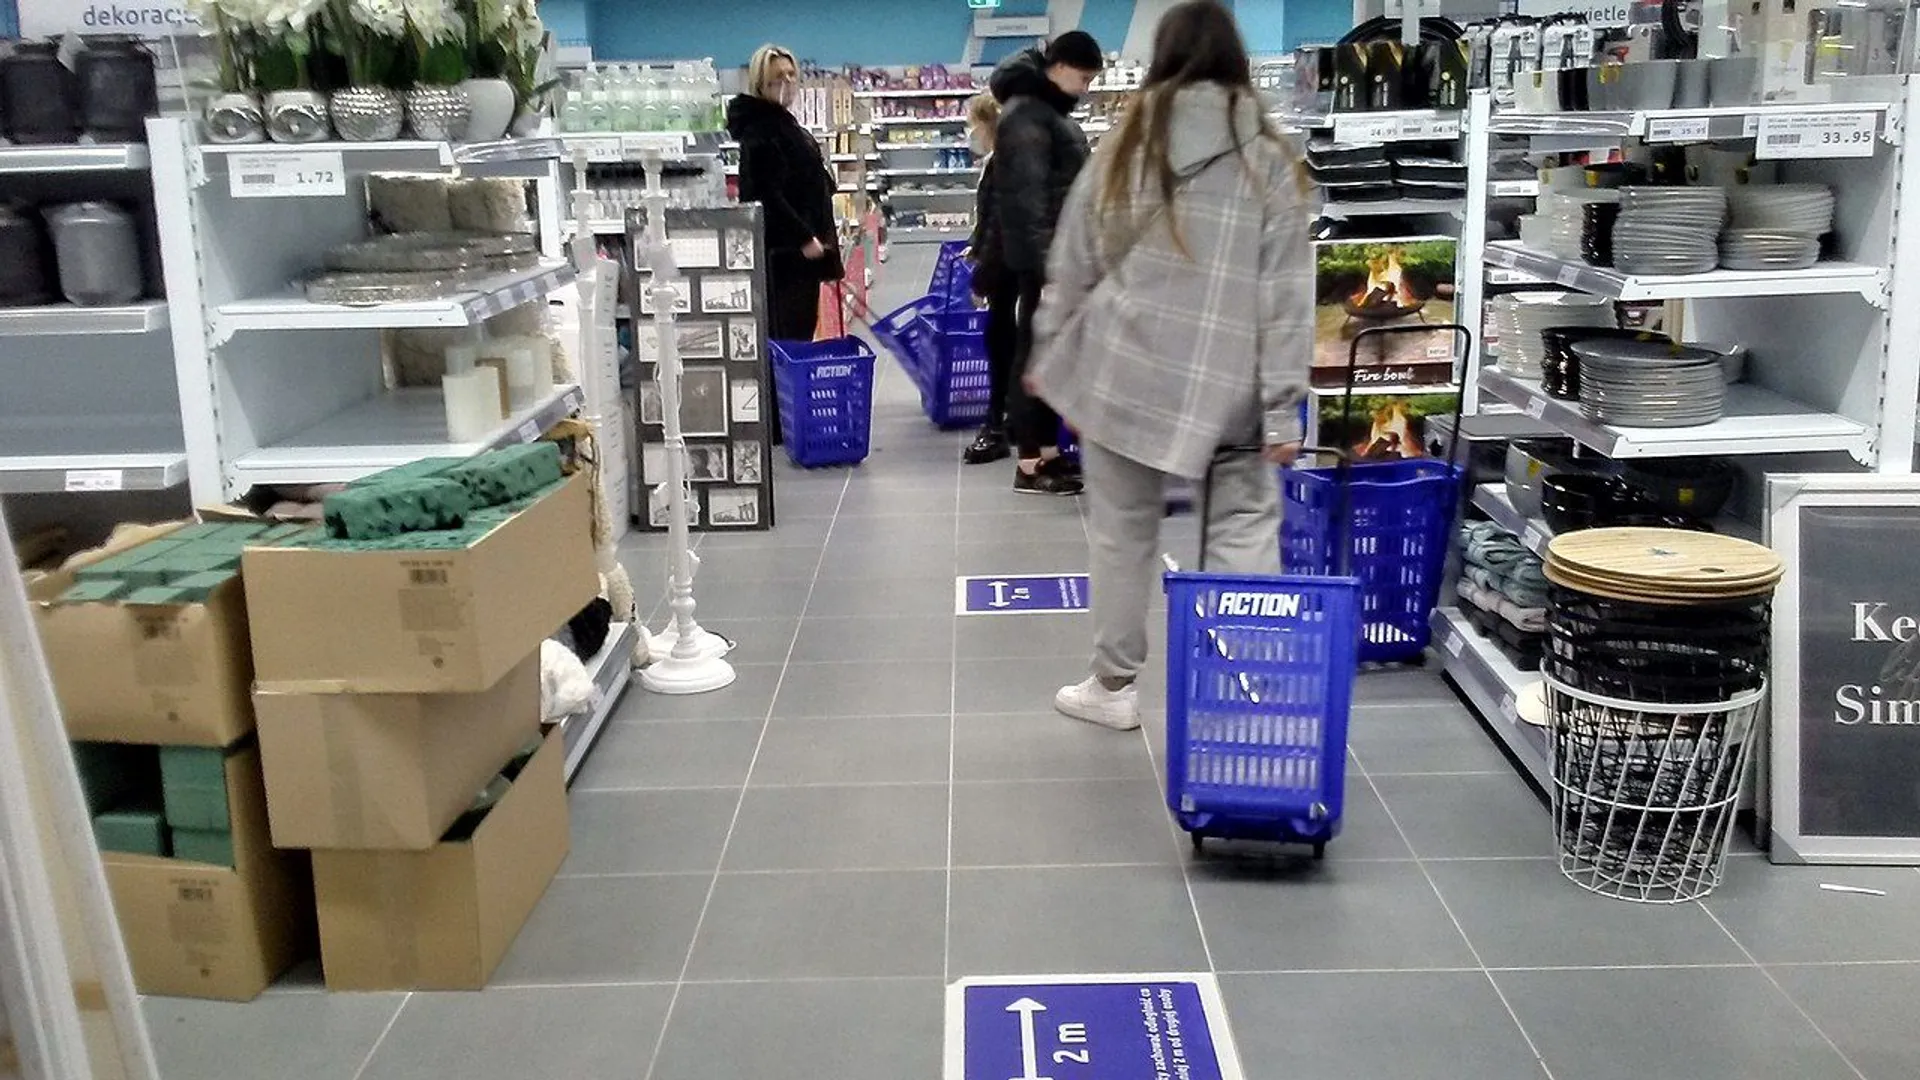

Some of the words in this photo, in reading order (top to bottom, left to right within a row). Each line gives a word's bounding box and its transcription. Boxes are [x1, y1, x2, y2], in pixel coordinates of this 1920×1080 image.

[1821, 130, 1872, 144] 33.95
[296, 171, 333, 184] 1.72
[816, 364, 852, 378] ACTION
[1352, 369, 1381, 381] Fire
[1382, 366, 1414, 381] bowl
[1217, 591, 1300, 617] ACTION
[1158, 988, 1173, 1009] osoby
[1139, 997, 1158, 1033] odległość
[1161, 1010, 1180, 1036] drugiej
[1058, 1022, 1087, 1043] m
[1167, 1037, 1182, 1048] od
[1052, 1049, 1090, 1064] 2
[1173, 1048, 1184, 1057] m
